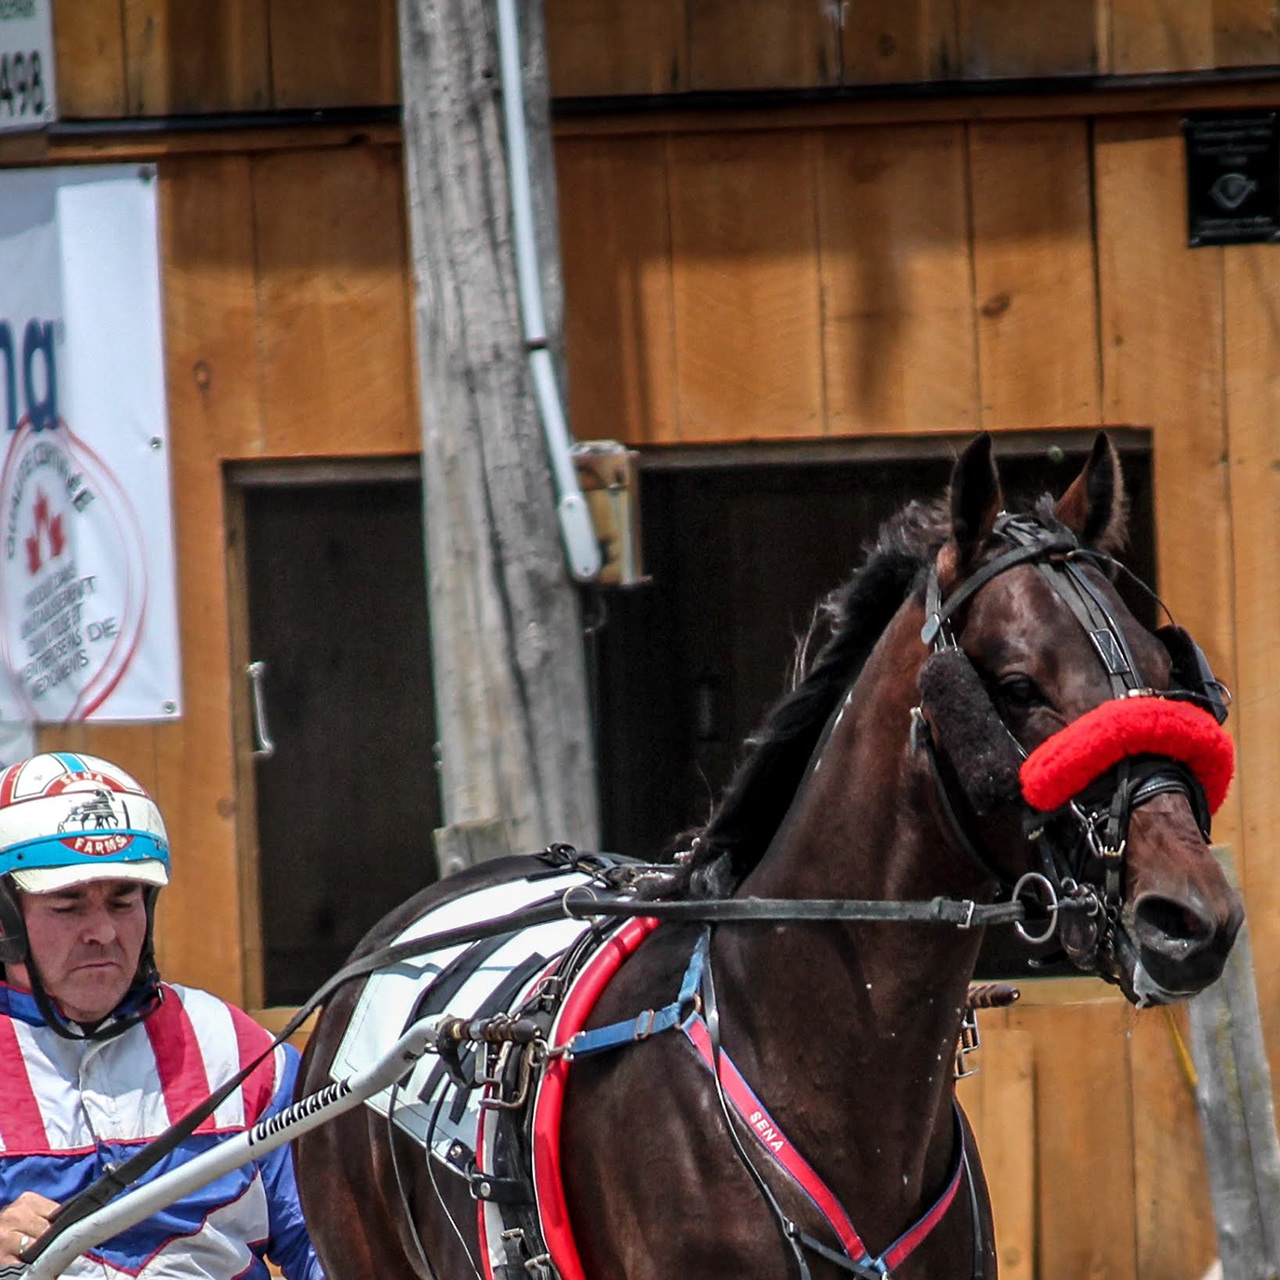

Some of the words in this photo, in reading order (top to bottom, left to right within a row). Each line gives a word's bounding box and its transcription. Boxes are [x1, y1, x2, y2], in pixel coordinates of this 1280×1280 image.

[74, 834, 128, 855] FARMS
[248, 1075, 352, 1146] TOMAHAWK
[749, 1111, 785, 1152] SENA
